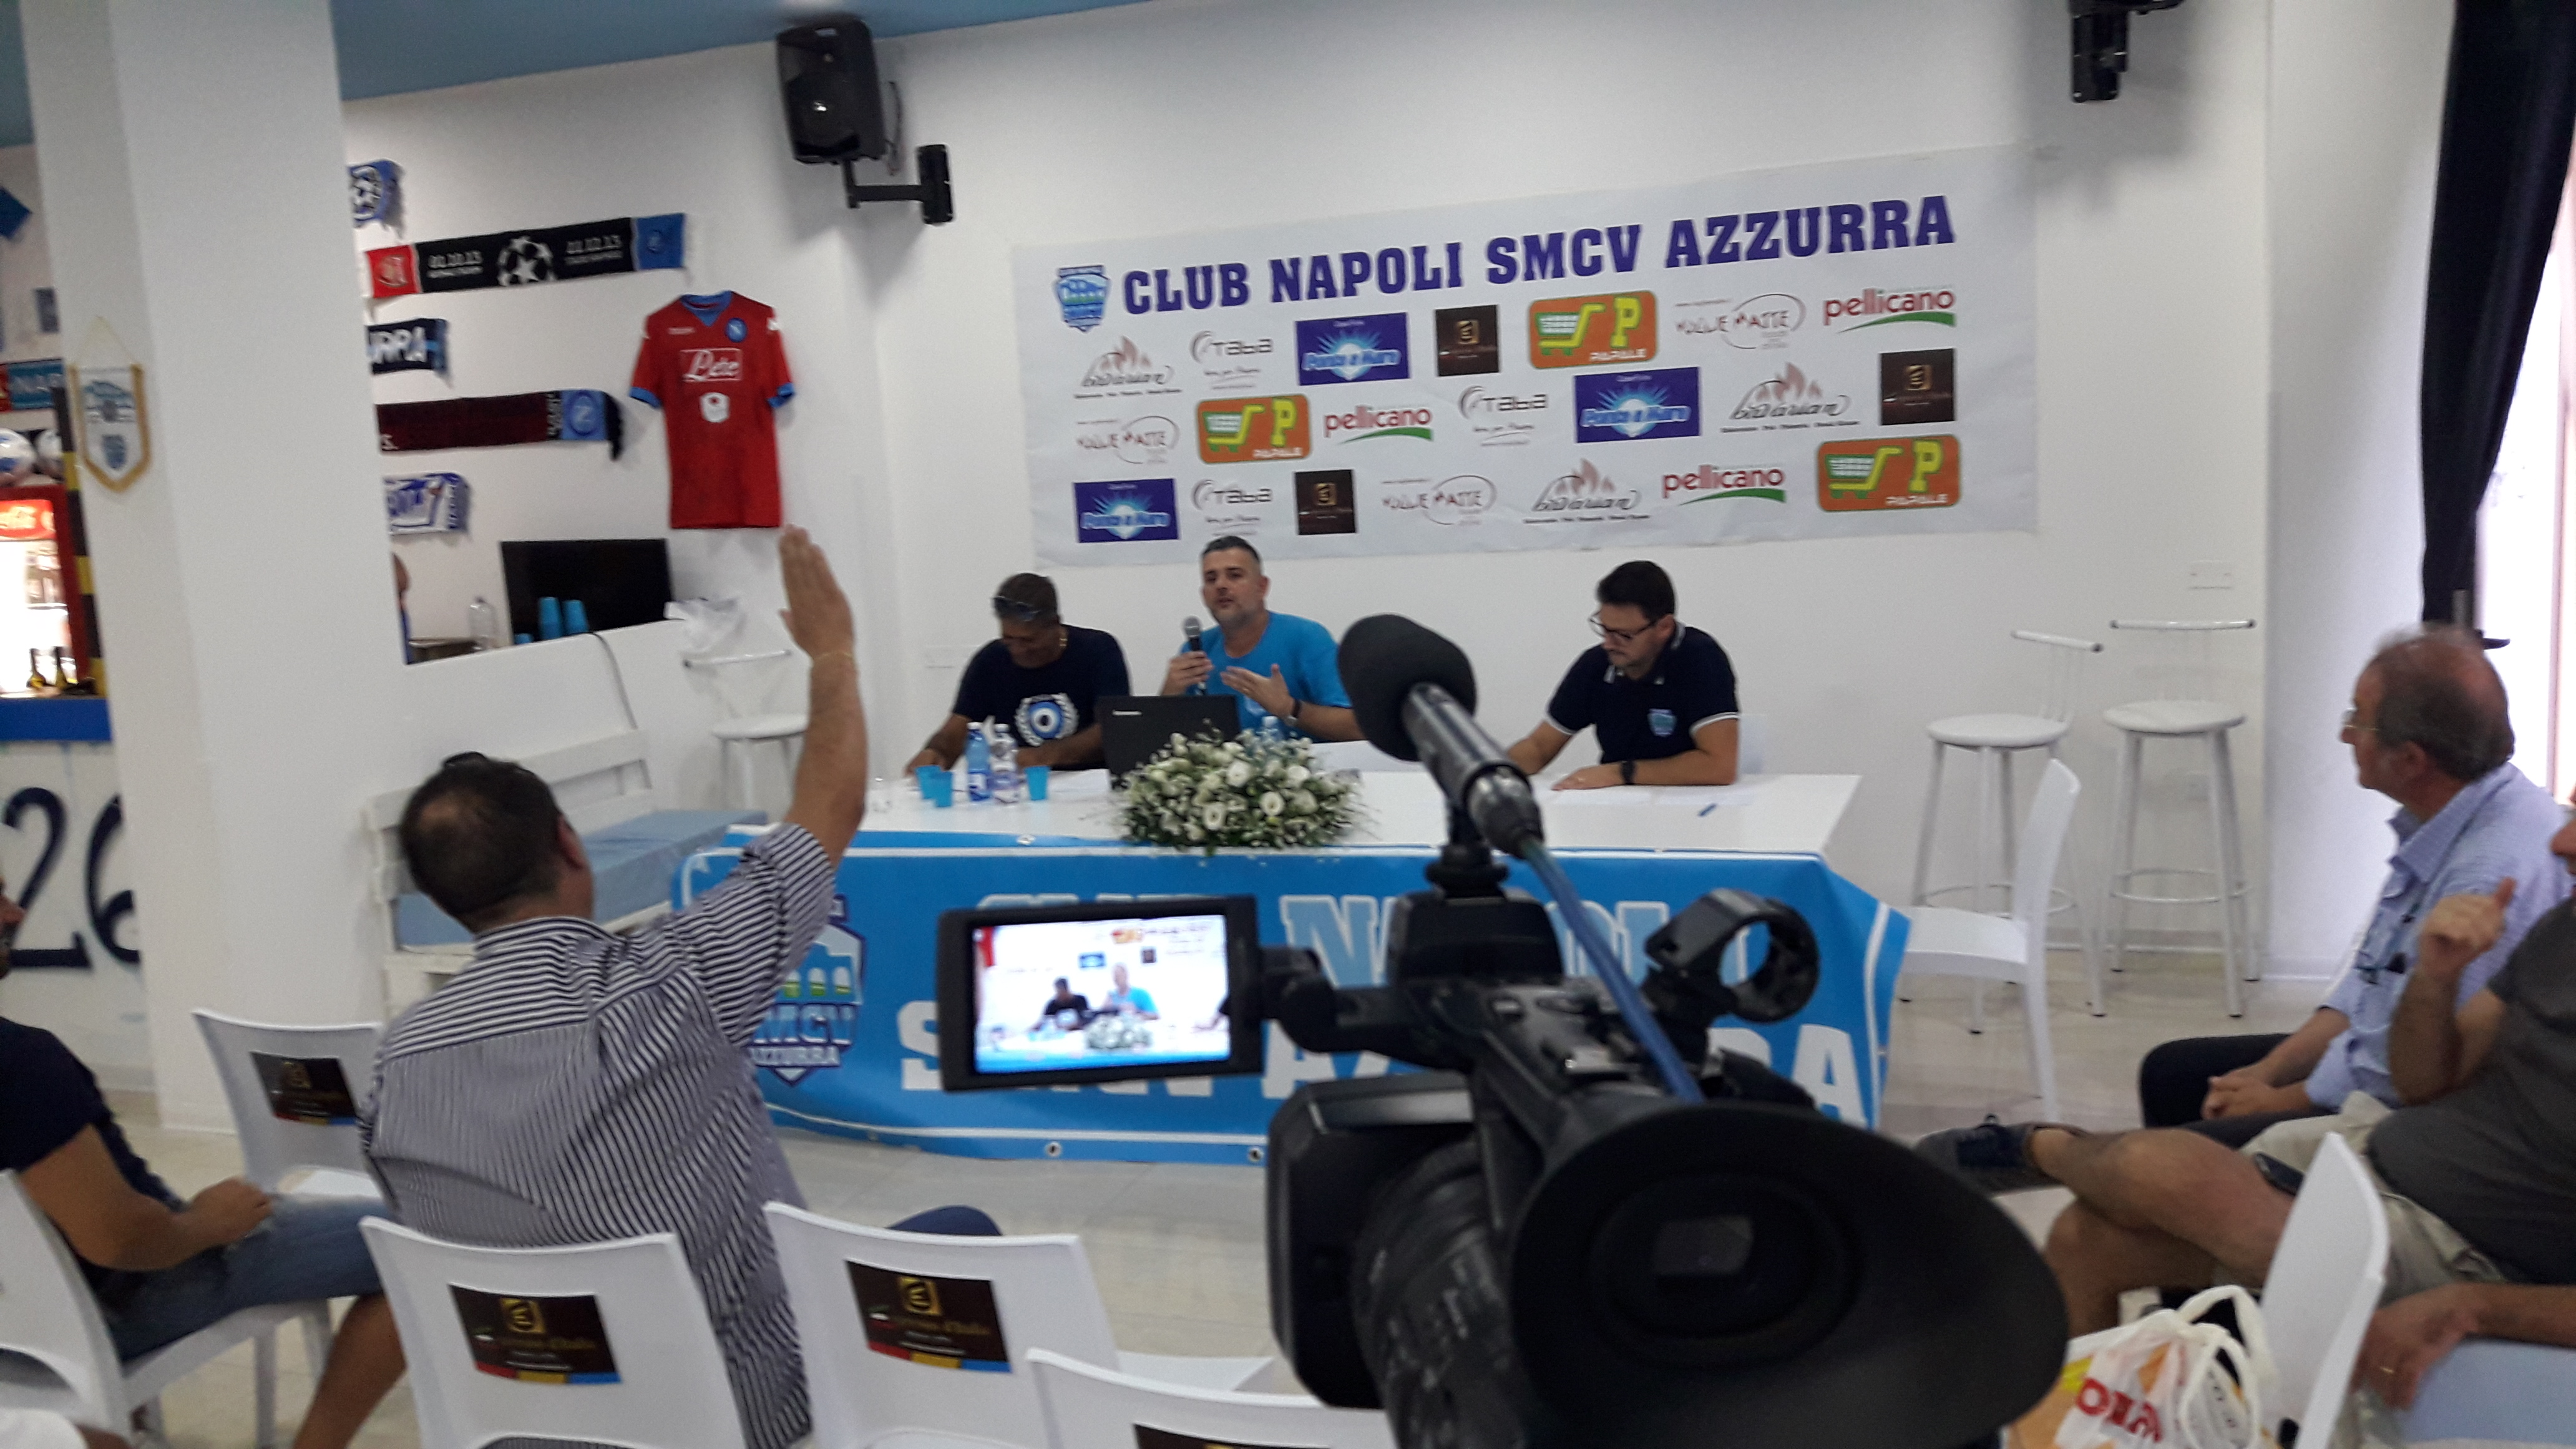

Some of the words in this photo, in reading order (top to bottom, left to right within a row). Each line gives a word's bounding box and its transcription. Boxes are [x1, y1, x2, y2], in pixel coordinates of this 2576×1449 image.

[1124, 262, 1249, 314] CLUB
[1269, 242, 1463, 303] NAPOLI
[1487, 223, 1642, 285] SMCV
[1665, 195, 1956, 268] AZZURRA
[1823, 288, 1954, 325] pellicano
[1324, 405, 1433, 438] pellicano
[1662, 464, 1785, 499] pellicano
